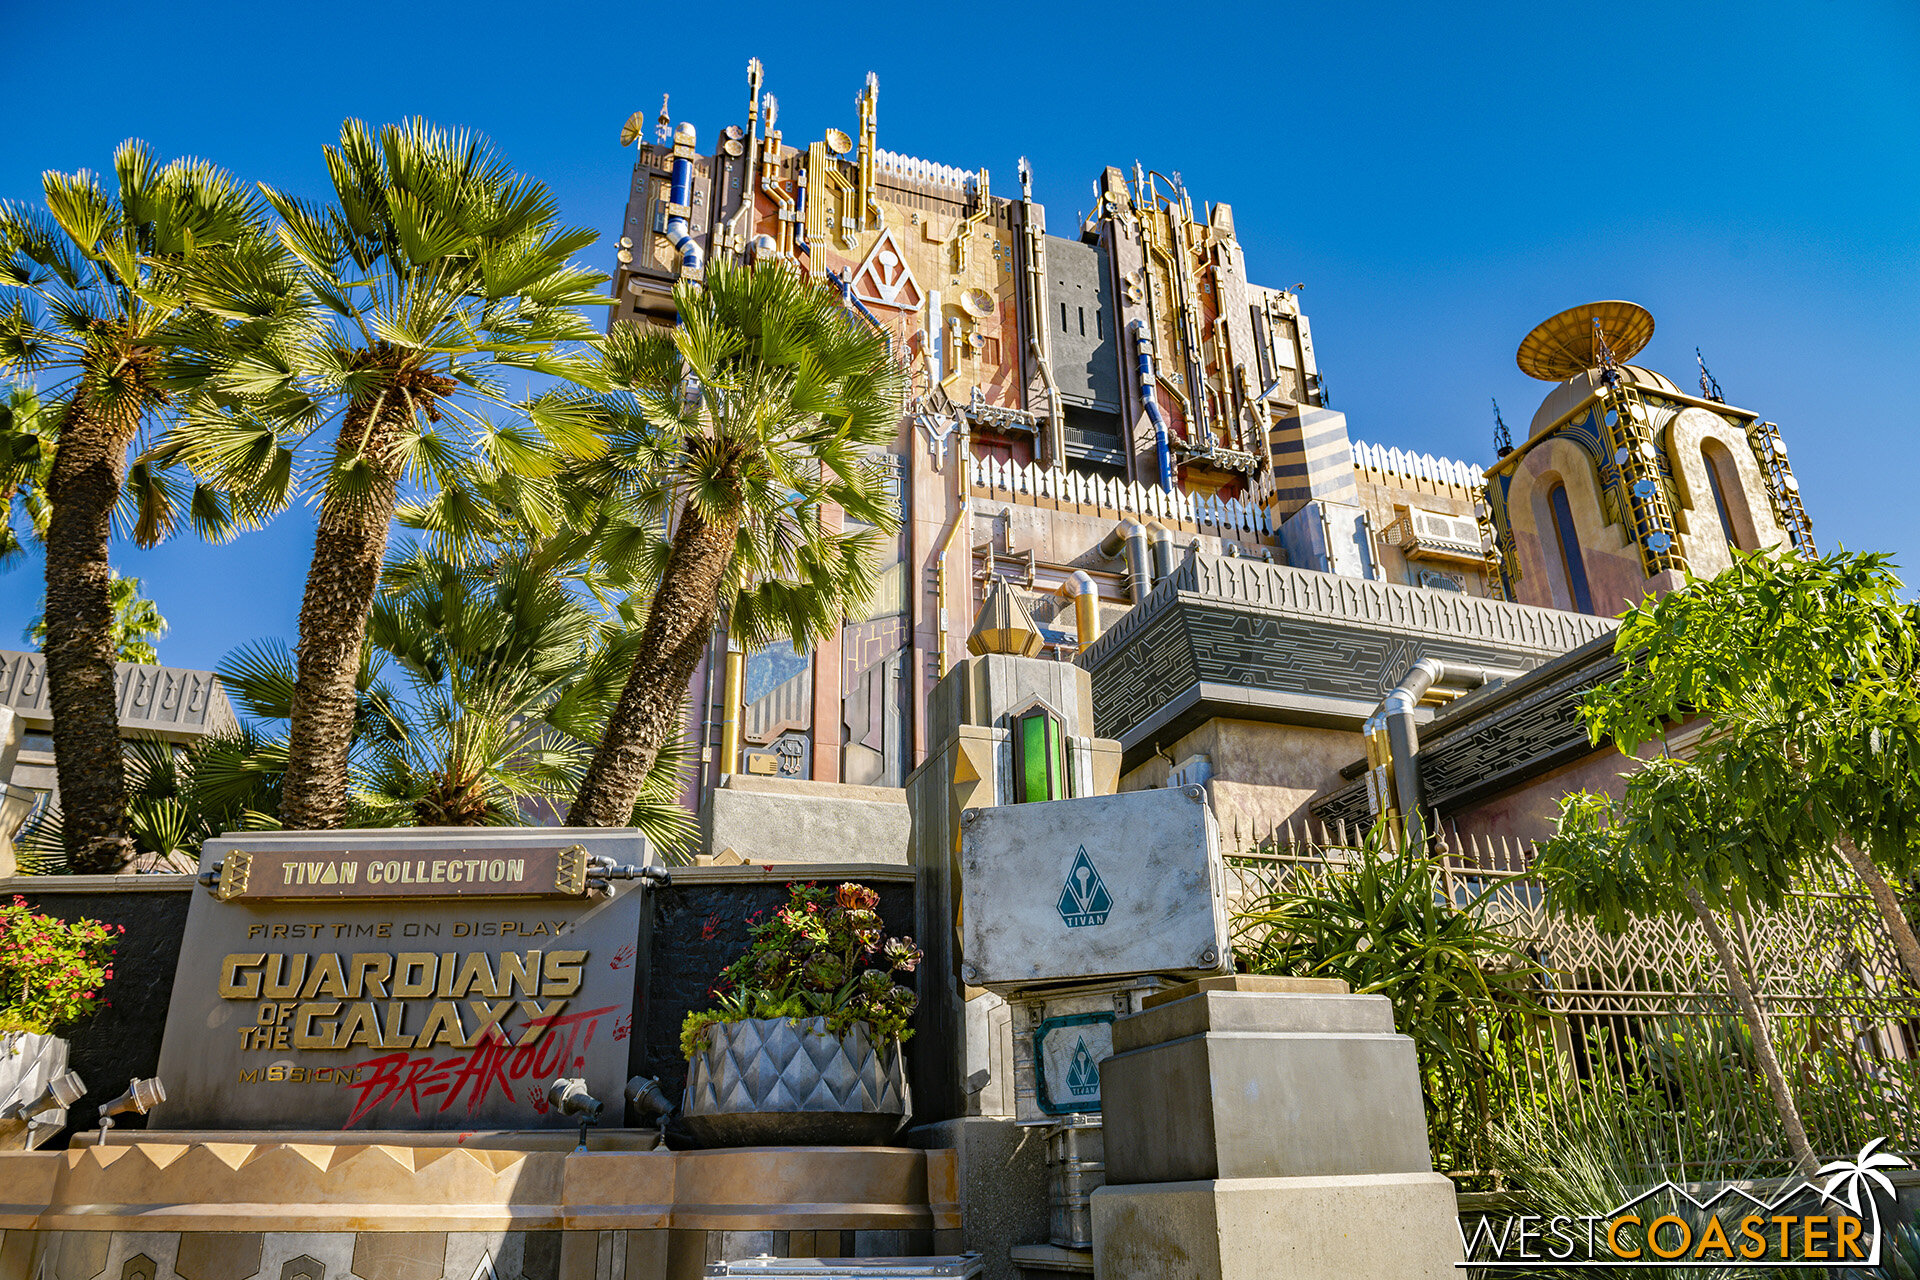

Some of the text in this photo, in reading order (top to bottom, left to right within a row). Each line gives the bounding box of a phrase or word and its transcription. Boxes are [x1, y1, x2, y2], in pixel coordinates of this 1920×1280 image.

[282, 858, 524, 885] TIVAN COLLECTION
[247, 920, 576, 940] FIRST TIME ON DISPLAY:
[1066, 914, 1105, 927] TIVAN
[218, 949, 591, 999] GUARDIANS
[238, 1000, 570, 1050] THE GALAXY
[256, 1002, 297, 1026] OF
[1072, 1087, 1097, 1096] TIVAN
